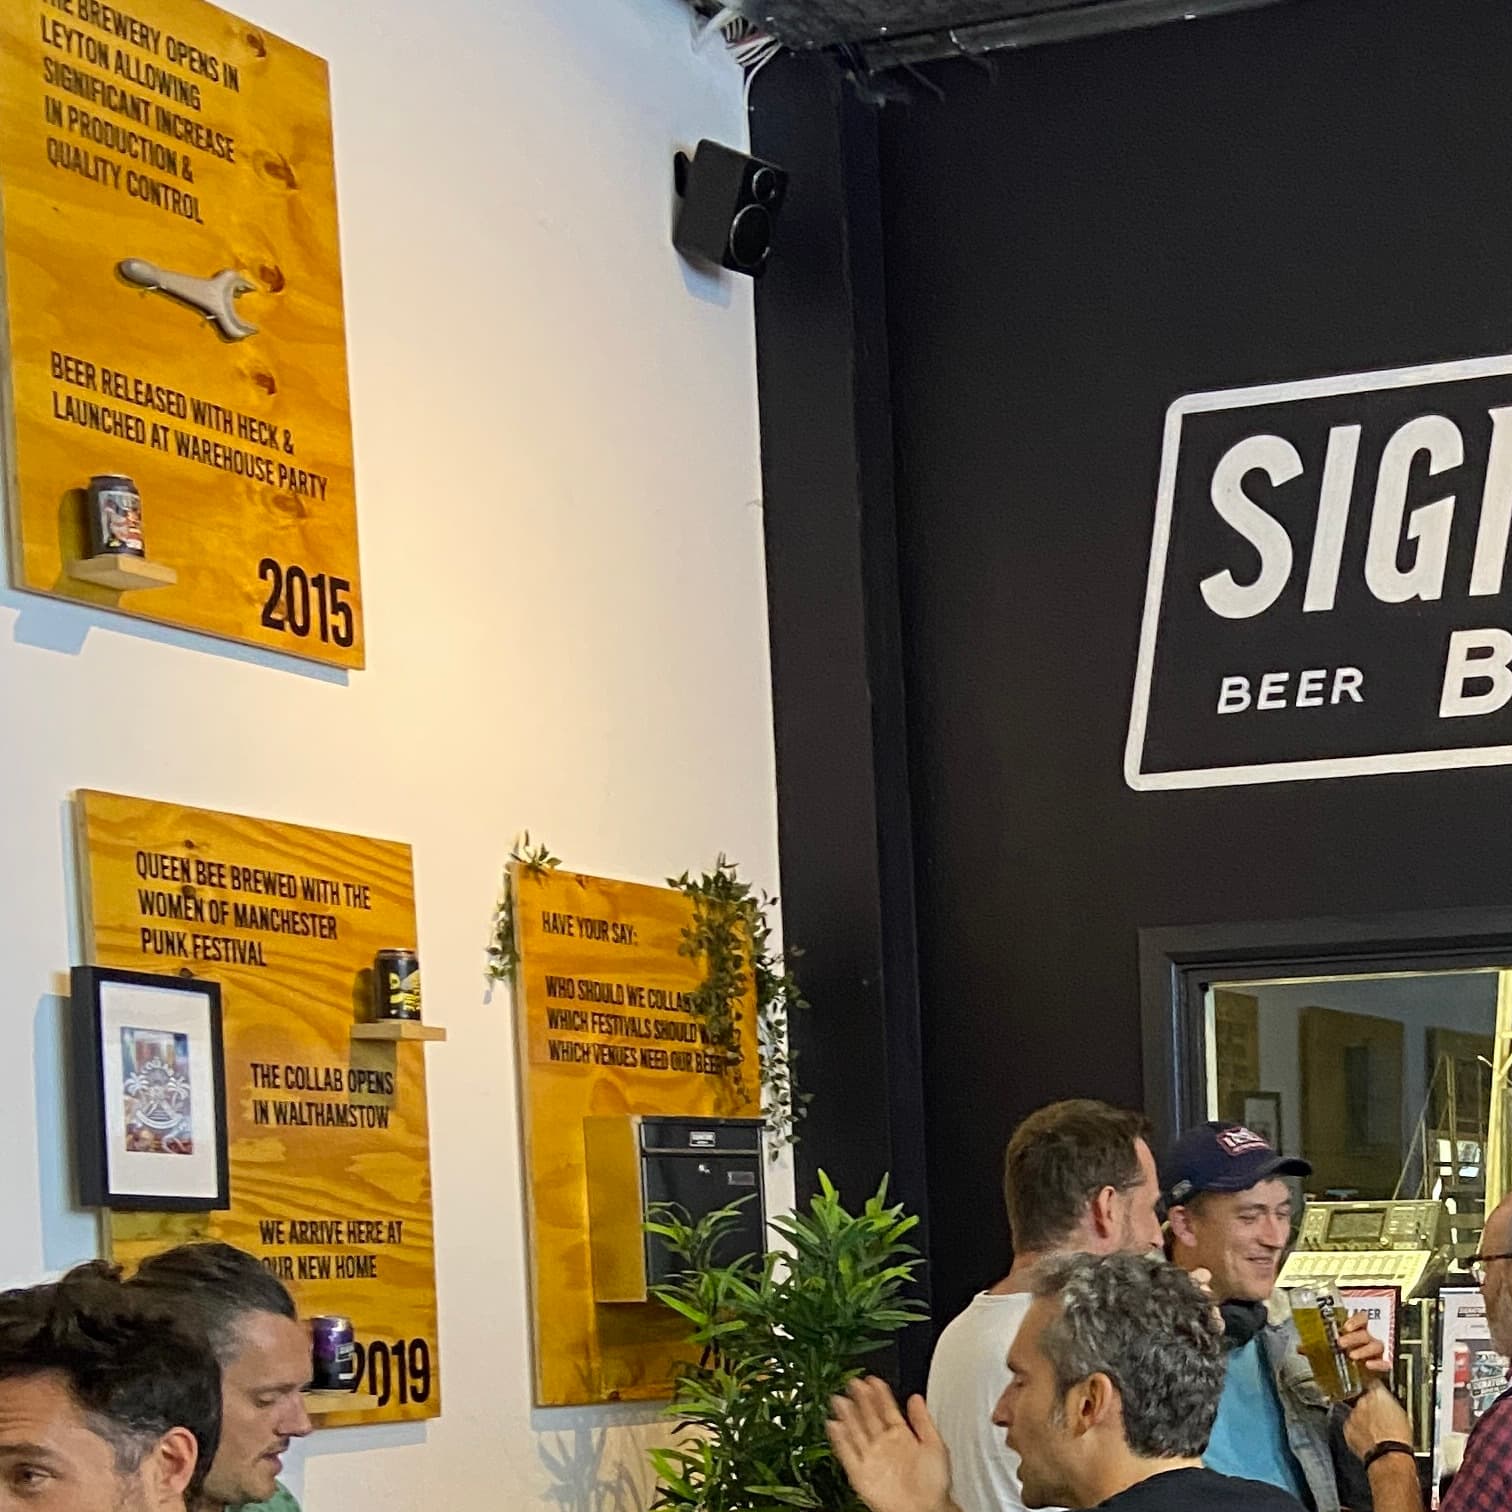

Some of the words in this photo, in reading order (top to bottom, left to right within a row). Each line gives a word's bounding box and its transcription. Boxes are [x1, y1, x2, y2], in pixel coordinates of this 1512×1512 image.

[41, 15, 109, 69] LEYTON
[114, 50, 201, 112] ALLOWING
[78, 0, 160, 55] BREWERY
[166, 35, 219, 82] OPENS
[223, 60, 240, 93] IN
[43, 56, 151, 125] SIGNIFICANT
[155, 97, 235, 163] INCREASE
[45, 95, 62, 128] IN
[68, 104, 178, 176] PRODUCTION
[181, 155, 194, 184] &
[47, 136, 121, 190] QUALITY
[126, 171, 204, 225] CONTROL
[51, 351, 97, 391] BEER
[102, 367, 187, 420] RELEASED
[190, 395, 233, 434] WITH
[238, 410, 279, 451] HECK
[283, 429, 295, 455] &
[52, 391, 146, 445] LAUNCHED
[151, 422, 170, 452] AT
[174, 430, 274, 486] WAREHOUSE
[279, 464, 328, 502] PARTY
[258, 557, 354, 648] 2015
[1217, 668, 1364, 714] BEER
[136, 851, 191, 884] QUEEN
[195, 859, 226, 890] BEE
[231, 865, 297, 899] BREWED
[300, 876, 340, 906] WITH
[344, 883, 372, 911] THE
[138, 889, 204, 923] WOMEN
[209, 900, 230, 925] OF
[234, 903, 338, 940] MANCHESTER
[542, 911, 574, 937] HAVE
[575, 915, 610, 943] YOUR
[141, 928, 189, 958] PUNK
[193, 935, 267, 967] FESTIVAL
[545, 975, 575, 1000] WHO
[578, 980, 625, 1005] SHOULD
[627, 984, 646, 1008] WE
[546, 1007, 588, 1033] WHICH
[591, 1012, 651, 1039] FESTIVALS
[653, 1019, 697, 1043] SHOULD
[251, 1063, 280, 1090] THE
[285, 1066, 343, 1092] COLLAB
[348, 1070, 393, 1095] OPENS
[548, 1039, 590, 1064] WHICH
[592, 1043, 637, 1068] VENUES
[640, 1048, 668, 1070] NEED
[670, 1050, 693, 1073] OUR
[253, 1099, 269, 1125] IN
[273, 1101, 390, 1129] WALTHAMSTOW
[259, 1220, 285, 1245] WE
[289, 1220, 344, 1245] ARRIVE
[347, 1220, 384, 1244] HERE
[387, 1220, 403, 1244] AT
[299, 1255, 330, 1280] NEW
[335, 1255, 377, 1279] HOME
